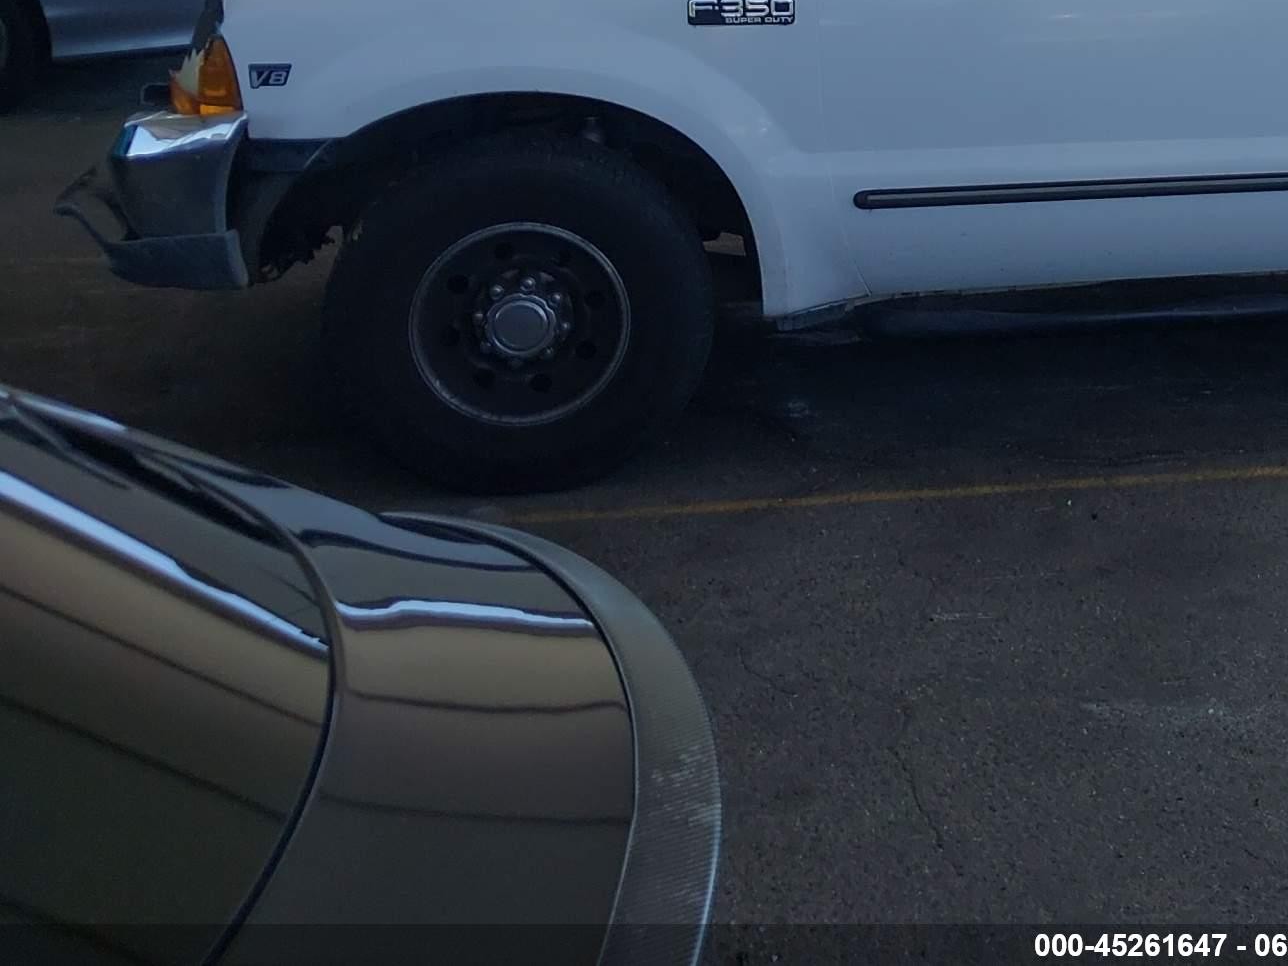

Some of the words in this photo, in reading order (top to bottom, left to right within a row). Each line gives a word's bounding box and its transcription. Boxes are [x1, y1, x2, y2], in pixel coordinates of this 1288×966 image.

[725, 16, 761, 24] SUPER
[764, 16, 794, 24] DUTY
[250, 69, 288, 87] V8
